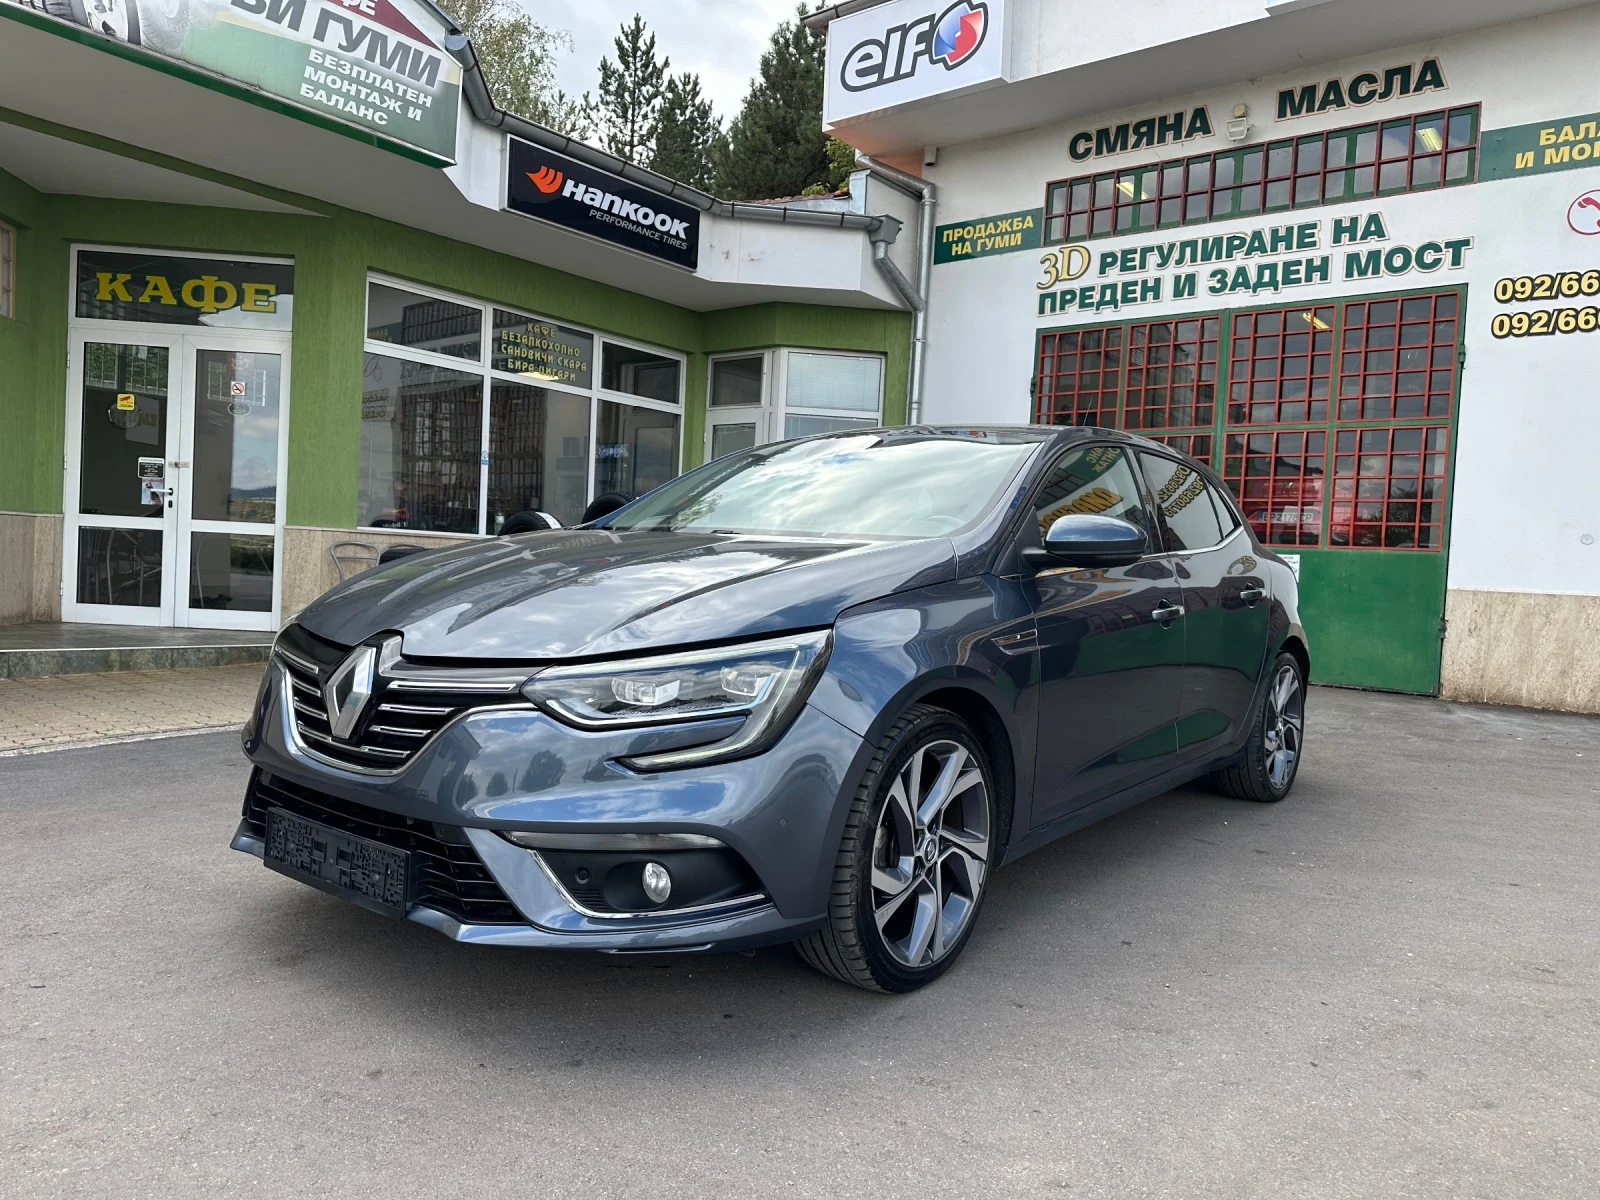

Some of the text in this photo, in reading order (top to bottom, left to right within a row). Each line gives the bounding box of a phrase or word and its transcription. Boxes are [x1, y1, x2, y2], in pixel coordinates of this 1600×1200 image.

[313, 7, 442, 89] ГУМИ
[840, 13, 937, 92] elf
[303, 65, 422, 122] МОНТАЖ И
[308, 48, 433, 108] БЕЗПЛАТЕН
[299, 82, 389, 125] БАЛАНС
[1068, 57, 1447, 161] СМЯНА МАСЛА
[1540, 121, 1600, 145] БАЛ
[1515, 151, 1534, 169] И
[588, 209, 688, 250] PERFORMANCE TIRES
[943, 215, 1034, 243] ПРОДАЖБА
[951, 233, 1022, 256] НА ГУМИ
[1037, 212, 1387, 290] 3D РЕГУЛИРАНЕ НА
[96, 272, 277, 314] КАФЕ
[1037, 237, 1473, 317] ПРЕДЕН И ЗАДЕН МОСТ
[528, 322, 556, 338] КАФЕ
[1491, 306, 1600, 339] 092/66
[507, 358, 576, 382] БИРА ЦИГАРИ
[557, 356, 587, 372] СКАРА
